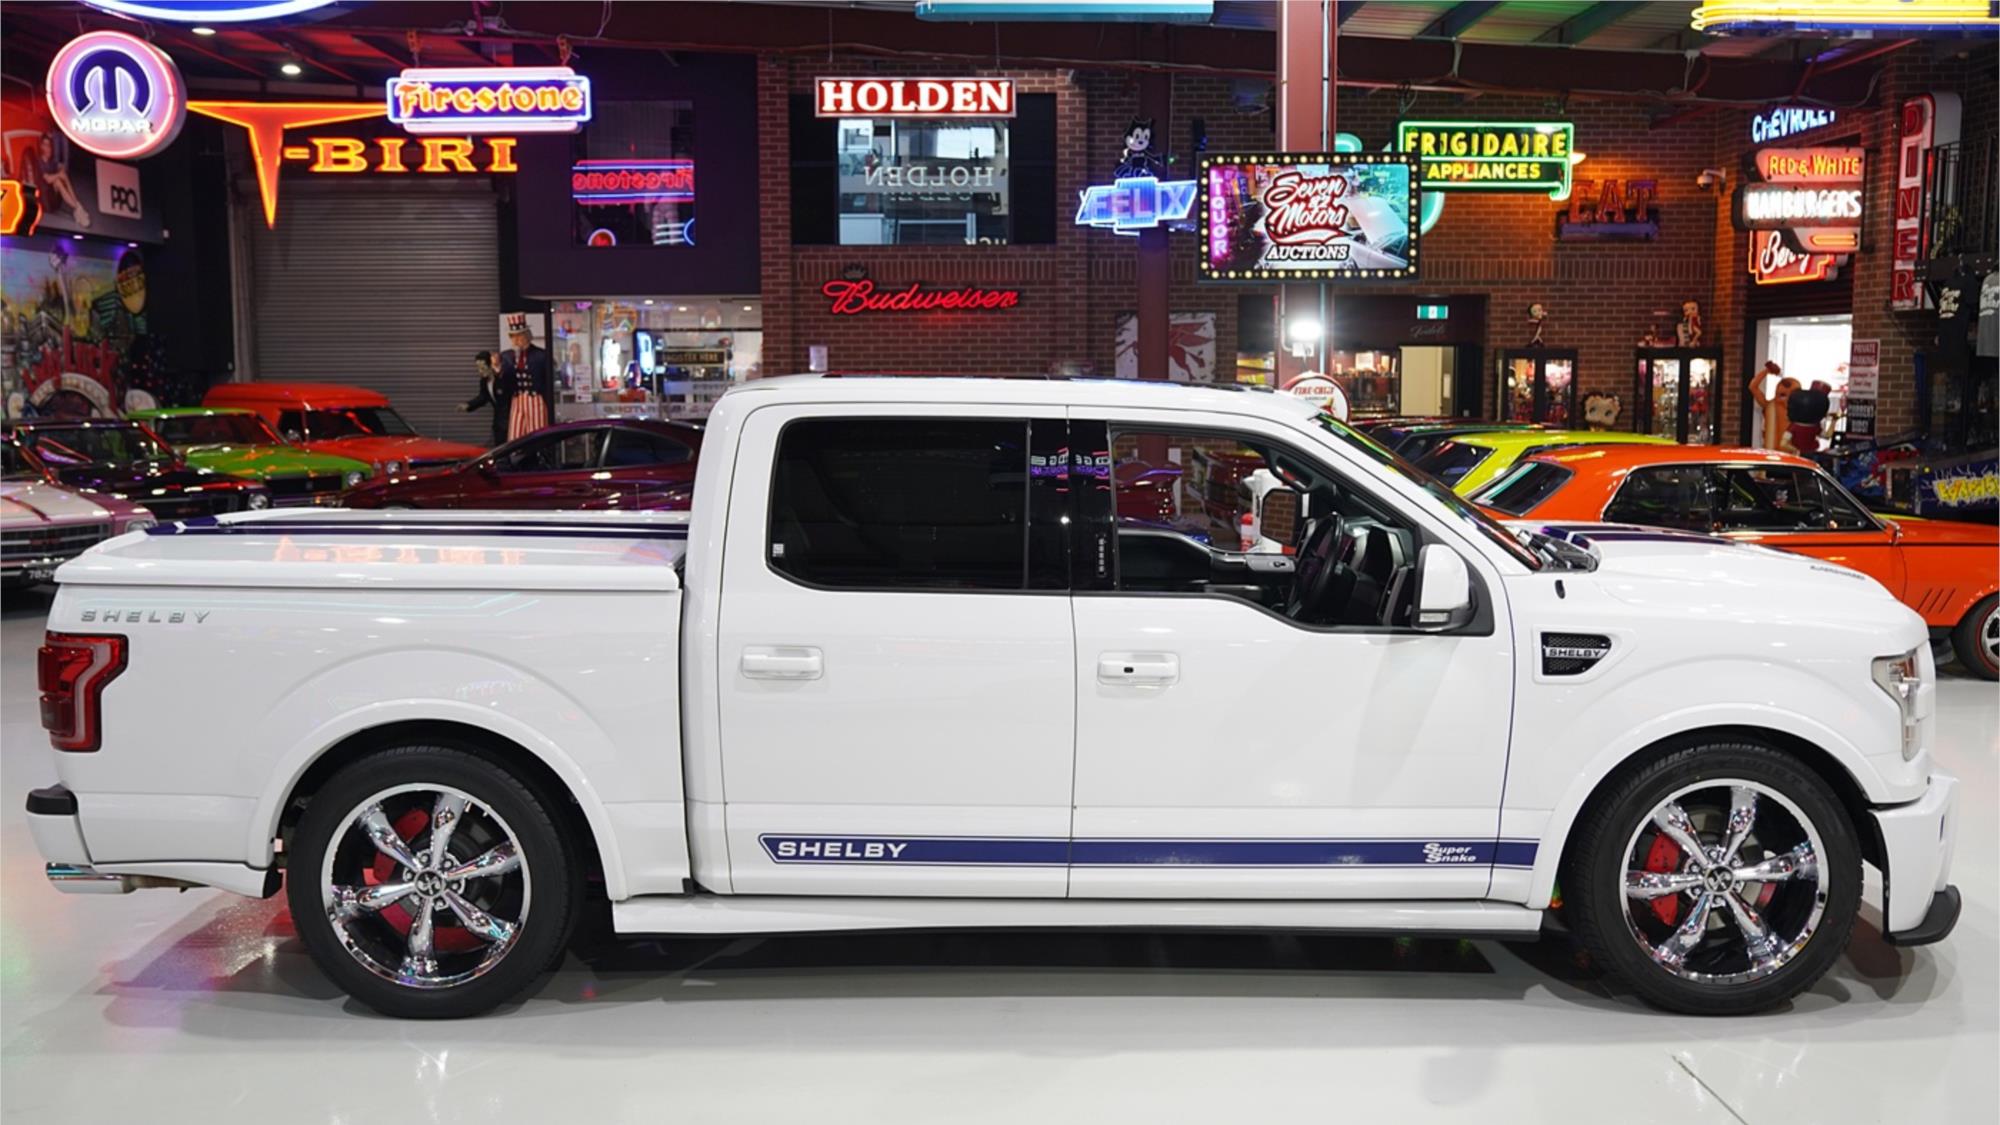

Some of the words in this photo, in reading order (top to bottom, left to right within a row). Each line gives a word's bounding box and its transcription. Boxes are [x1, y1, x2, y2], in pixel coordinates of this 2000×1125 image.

[395, 81, 584, 117] Firestone
[821, 81, 1010, 112] HOLDEN
[70, 117, 153, 134] MOPAR
[1405, 132, 1567, 157] FRIGIDAIRE
[1427, 163, 1540, 180] APPLIANCES
[1770, 156, 1795, 175] RED
[1797, 157, 1809, 176] &
[1811, 154, 1861, 175] WHITE
[1089, 185, 1189, 219] FELIX
[1266, 173, 1345, 208] Seven
[1568, 178, 1658, 224] EAT
[1747, 189, 1862, 219] HAMBURGERS
[1894, 102, 1922, 302] DINER
[1210, 169, 1228, 258] LIQUOR
[1268, 202, 1345, 234] Motors
[1266, 245, 1348, 260] AUCTIONS
[823, 280, 1019, 314] Budweiser
[81, 610, 210, 623] SHELBY
[1549, 648, 1601, 657] SHELBY
[777, 841, 907, 858] SHELBY
[1422, 843, 1473, 855] Super
[1425, 853, 1477, 863] Snake
